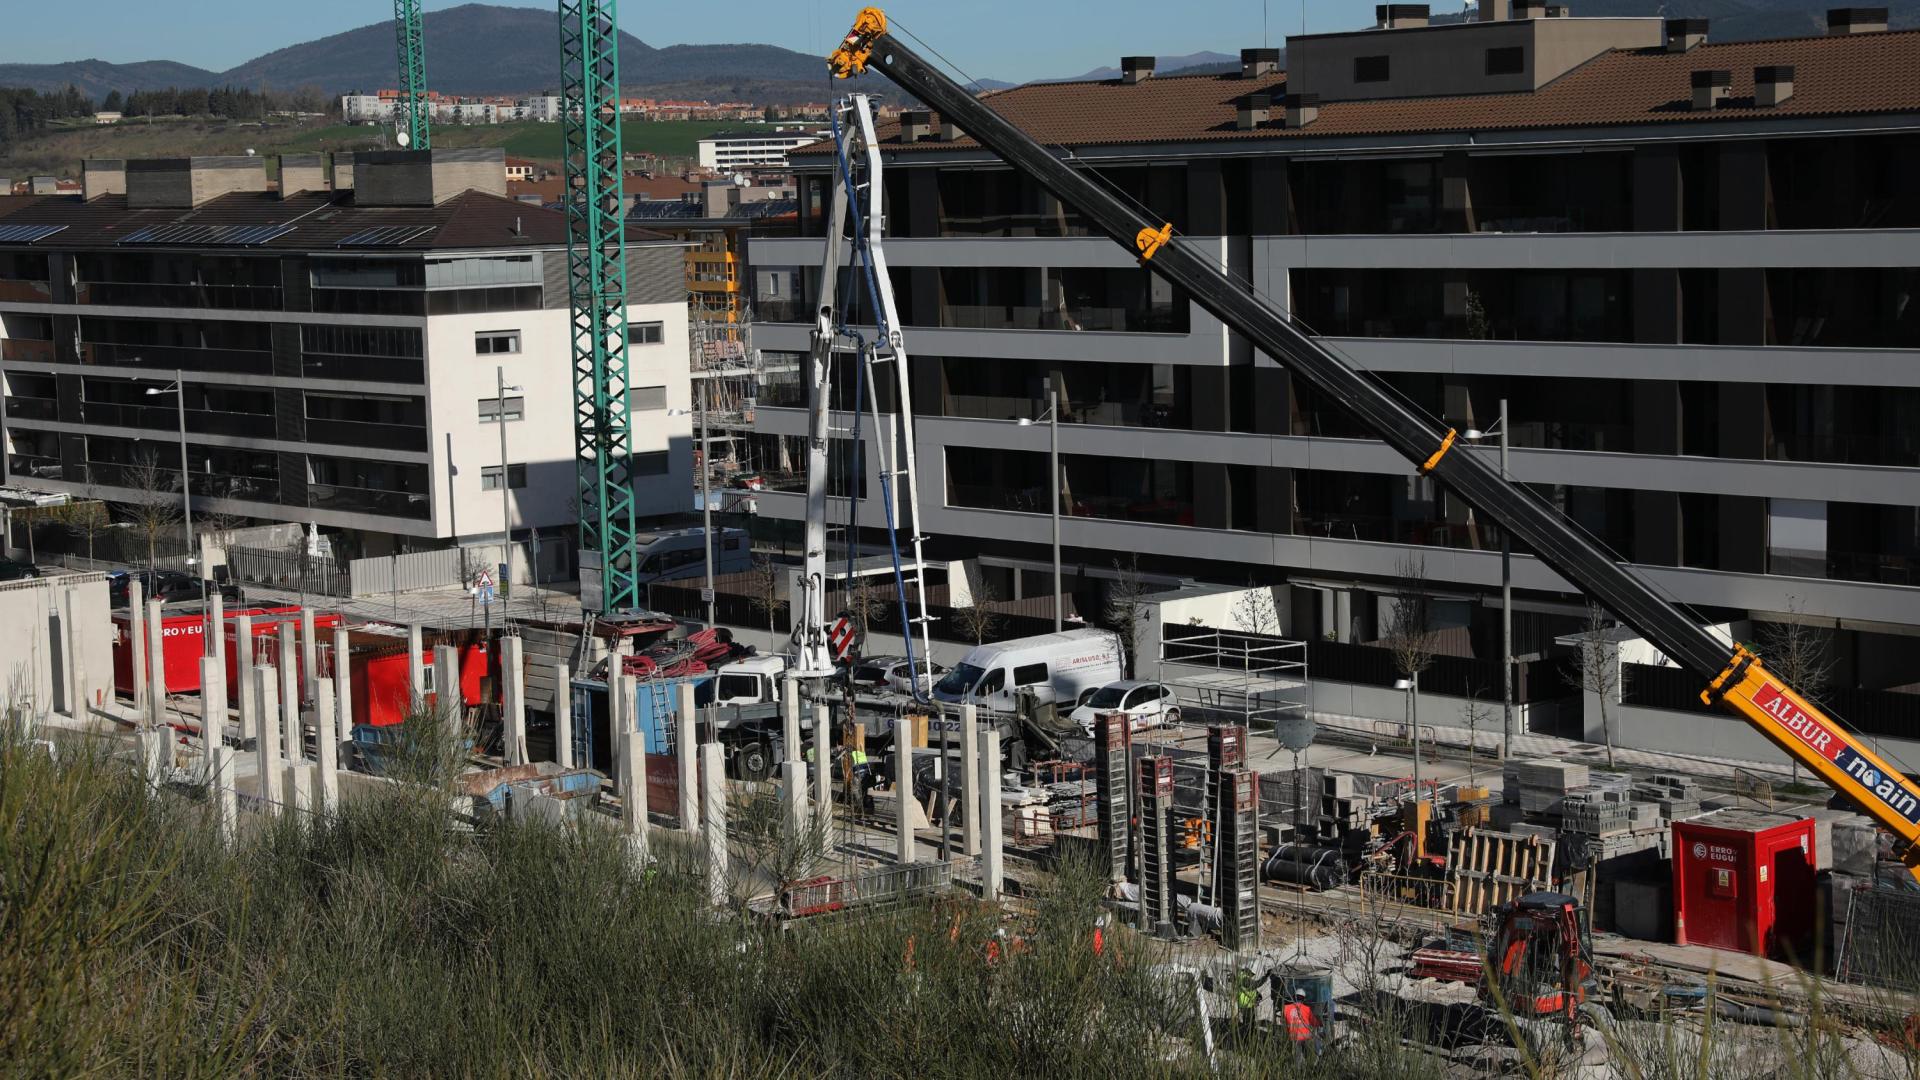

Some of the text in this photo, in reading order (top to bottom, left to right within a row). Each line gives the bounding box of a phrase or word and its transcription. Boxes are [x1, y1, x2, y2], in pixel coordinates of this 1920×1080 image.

[1764, 696, 1832, 752] ALBUR
[1846, 756, 1917, 816] noain
[1710, 844, 1733, 855] ERRO
